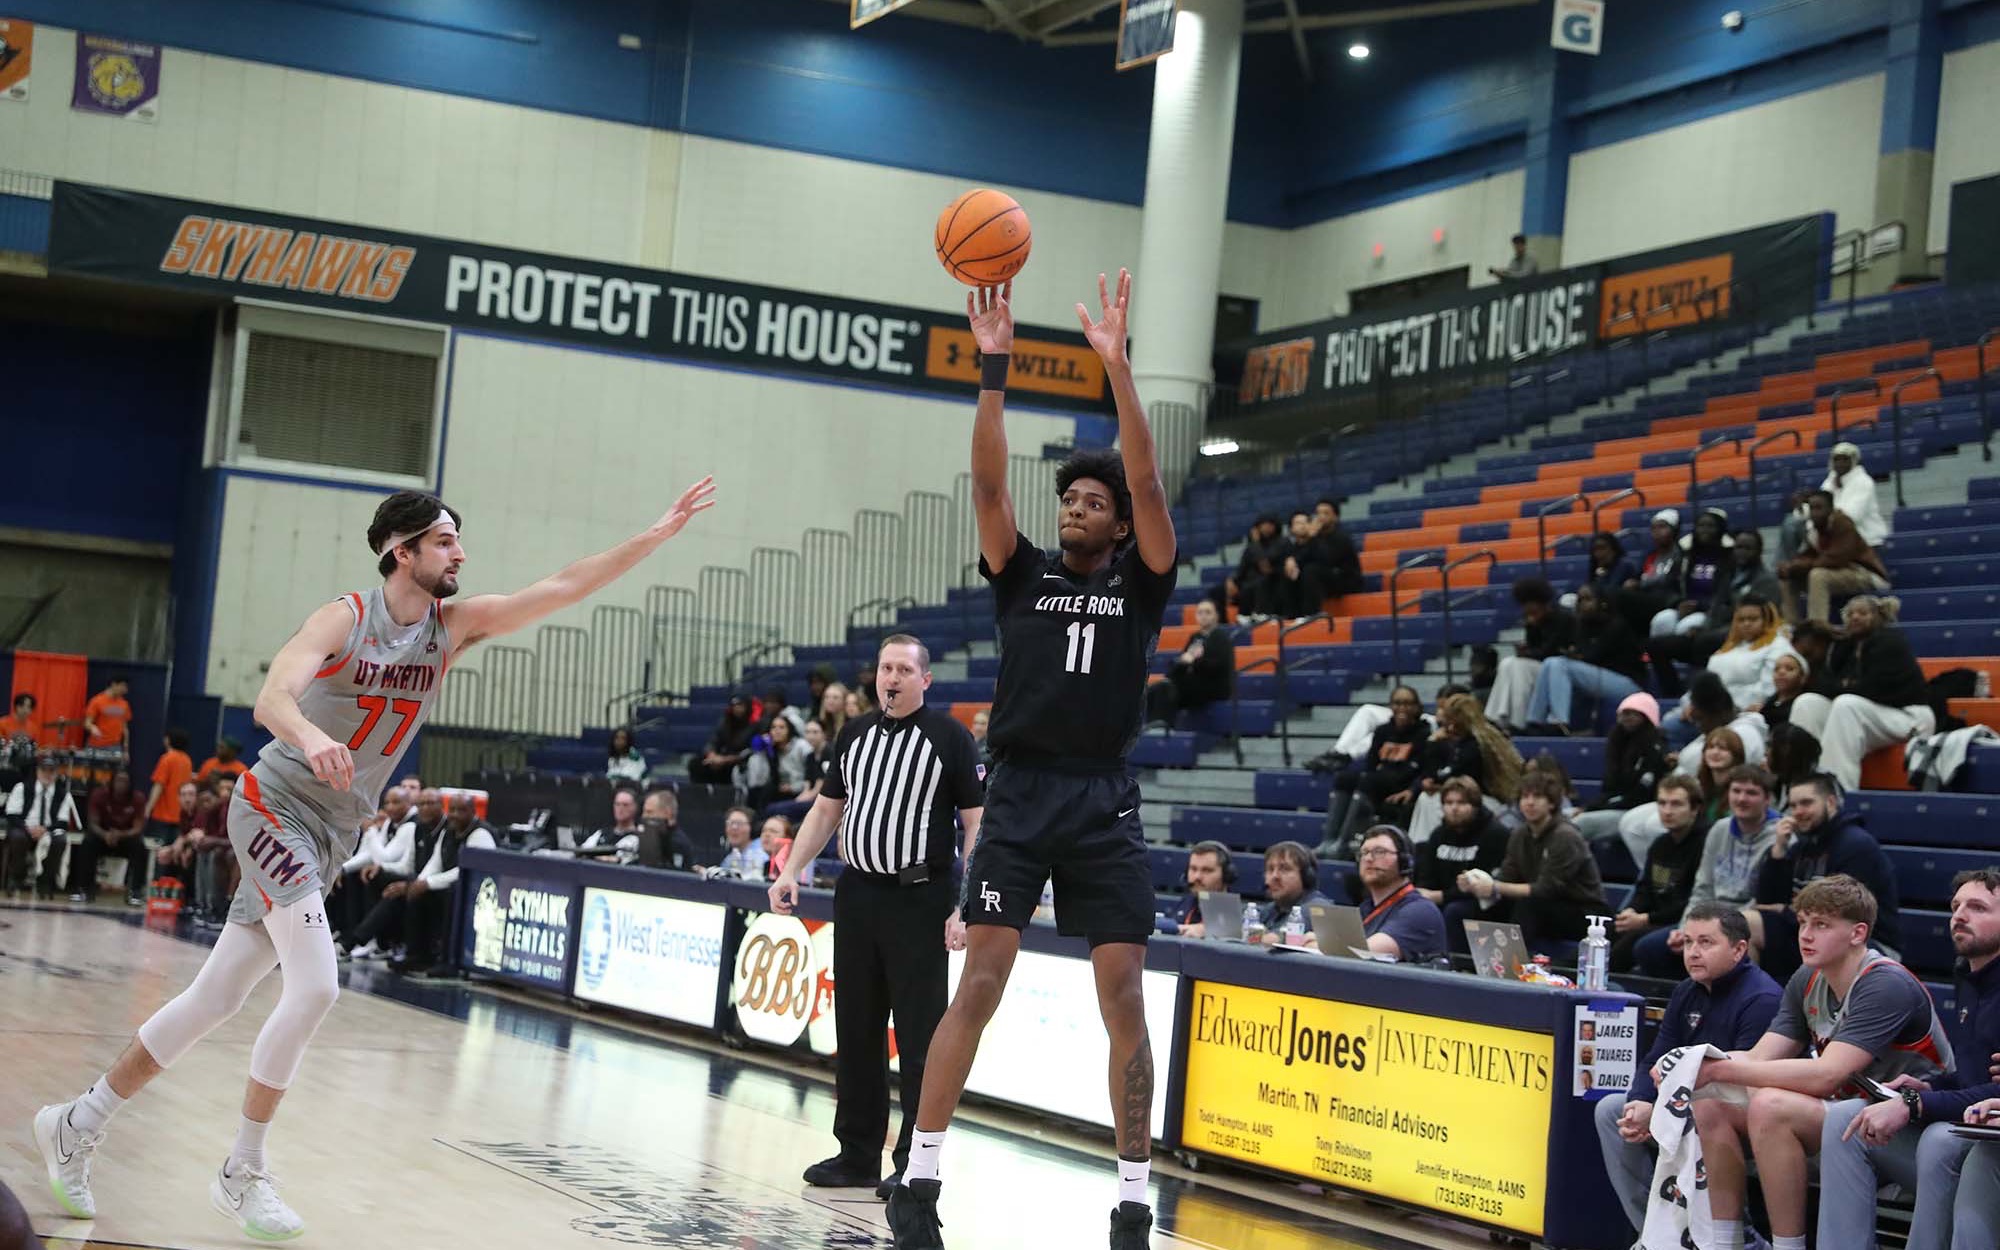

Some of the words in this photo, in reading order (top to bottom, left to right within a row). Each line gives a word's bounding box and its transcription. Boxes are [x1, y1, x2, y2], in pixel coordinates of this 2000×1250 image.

[1562, 14, 1592, 44] G
[160, 215, 416, 302] SKYHAWKS
[445, 255, 661, 338] PROTECT
[669, 287, 750, 351] THIS
[1035, 595, 1085, 613] LITTLE
[1086, 595, 1125, 616] ROCK
[1065, 621, 1096, 674] 11
[353, 659, 380, 686] UT
[347, 694, 422, 756] 77
[247, 826, 305, 887] UTM
[508, 888, 570, 928] SKYHAWK
[980, 881, 1002, 912] LR
[504, 922, 566, 961] RENTALS
[617, 909, 652, 954] West
[1196, 993, 1284, 1057] Edward
[1384, 1028, 1548, 1092] INVESTMENTS
[1596, 1025, 1634, 1038] JAMES
[1596, 1048, 1632, 1062] TAVARES
[1598, 1074, 1630, 1087] DAVIS
[1257, 1082, 1300, 1111] Martin,
[1303, 1091, 1320, 1114] TN
[1329, 1097, 1388, 1130] Financial
[1391, 1110, 1448, 1143] Advisors
[1316, 1136, 1333, 1156] Tony
[1334, 1140, 1372, 1161] Robinson
[1415, 1160, 1450, 1180] Jennifer
[1497, 1179, 1526, 1199] AAMS
